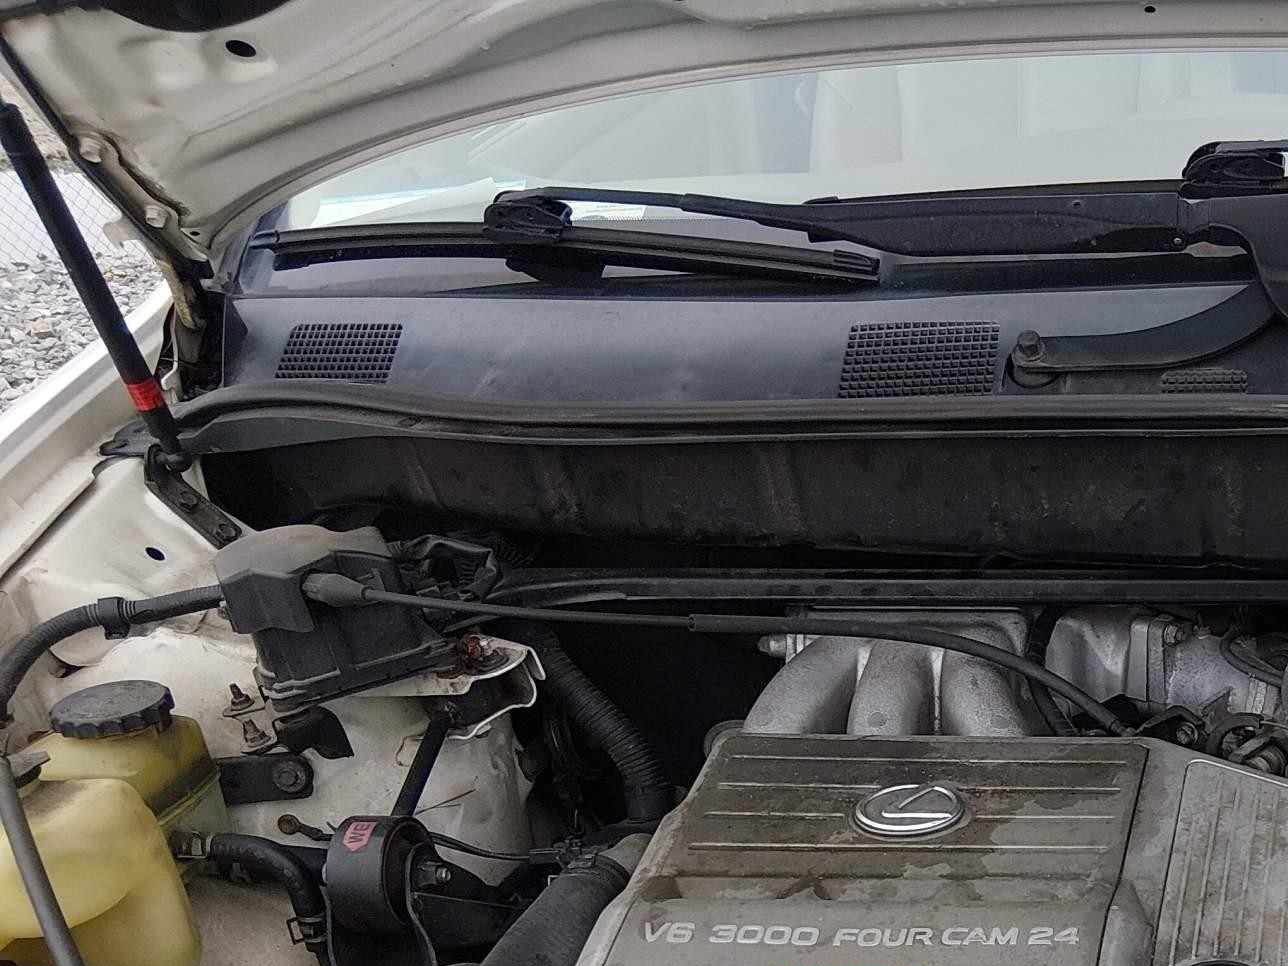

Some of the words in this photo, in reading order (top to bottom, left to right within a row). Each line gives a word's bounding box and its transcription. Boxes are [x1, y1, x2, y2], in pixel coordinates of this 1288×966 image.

[643, 922, 696, 944] V6
[709, 924, 820, 947] 3000
[832, 927, 934, 947] FOUR
[942, 927, 1019, 947] CAM
[1029, 927, 1080, 946] 24
